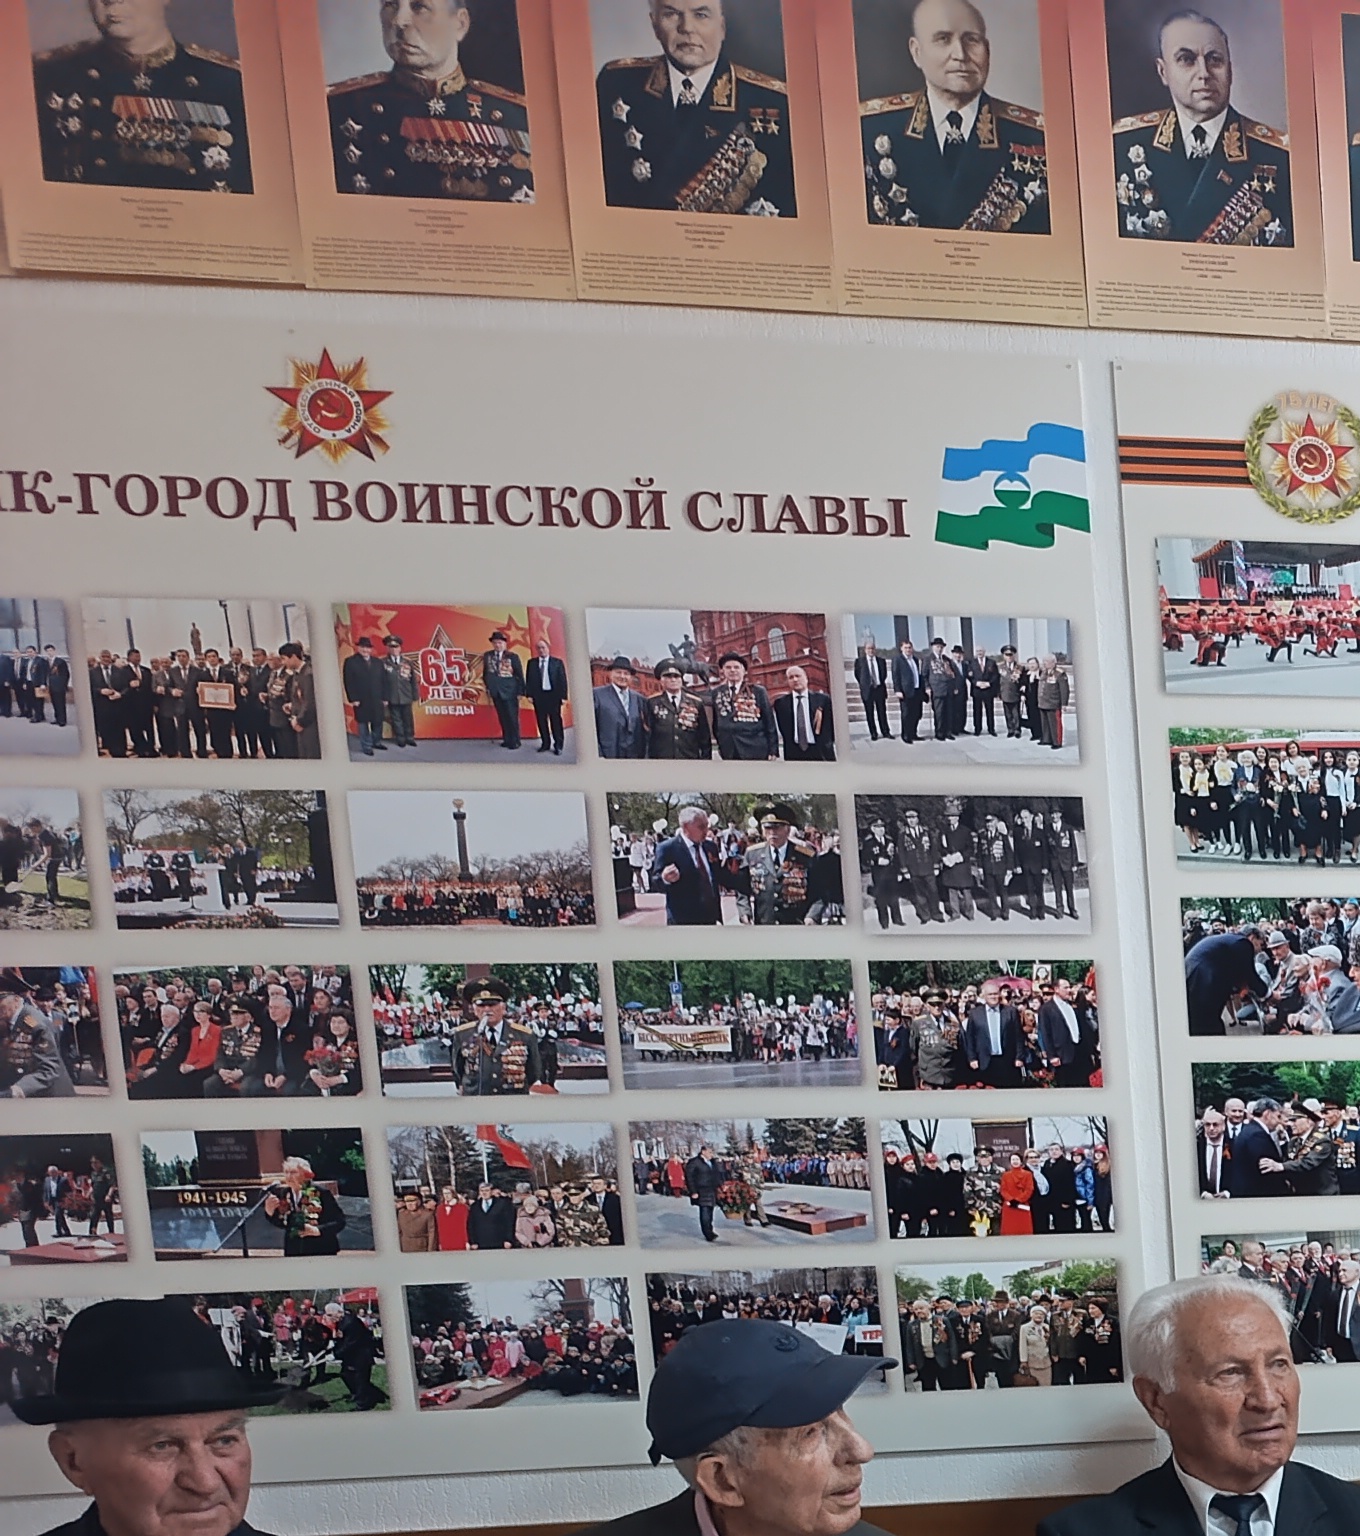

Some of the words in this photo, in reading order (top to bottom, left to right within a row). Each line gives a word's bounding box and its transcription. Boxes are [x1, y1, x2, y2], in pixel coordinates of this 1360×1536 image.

[300, 381, 355, 434] ОТЕЧЕСТВЕННАЯ
[345, 401, 362, 434] ВОЙНА
[1305, 393, 1338, 413] ЛЕТ
[0, 471, 296, 531] К-ГОРОД
[311, 478, 670, 532] ВОИНСКОЙ
[686, 493, 911, 538] СЛАВЫ
[419, 648, 469, 687] 65
[429, 687, 463, 699] ЛЕТ
[426, 705, 474, 716] ПОБЕДЫ
[178, 1191, 247, 1204] 1941-1945
